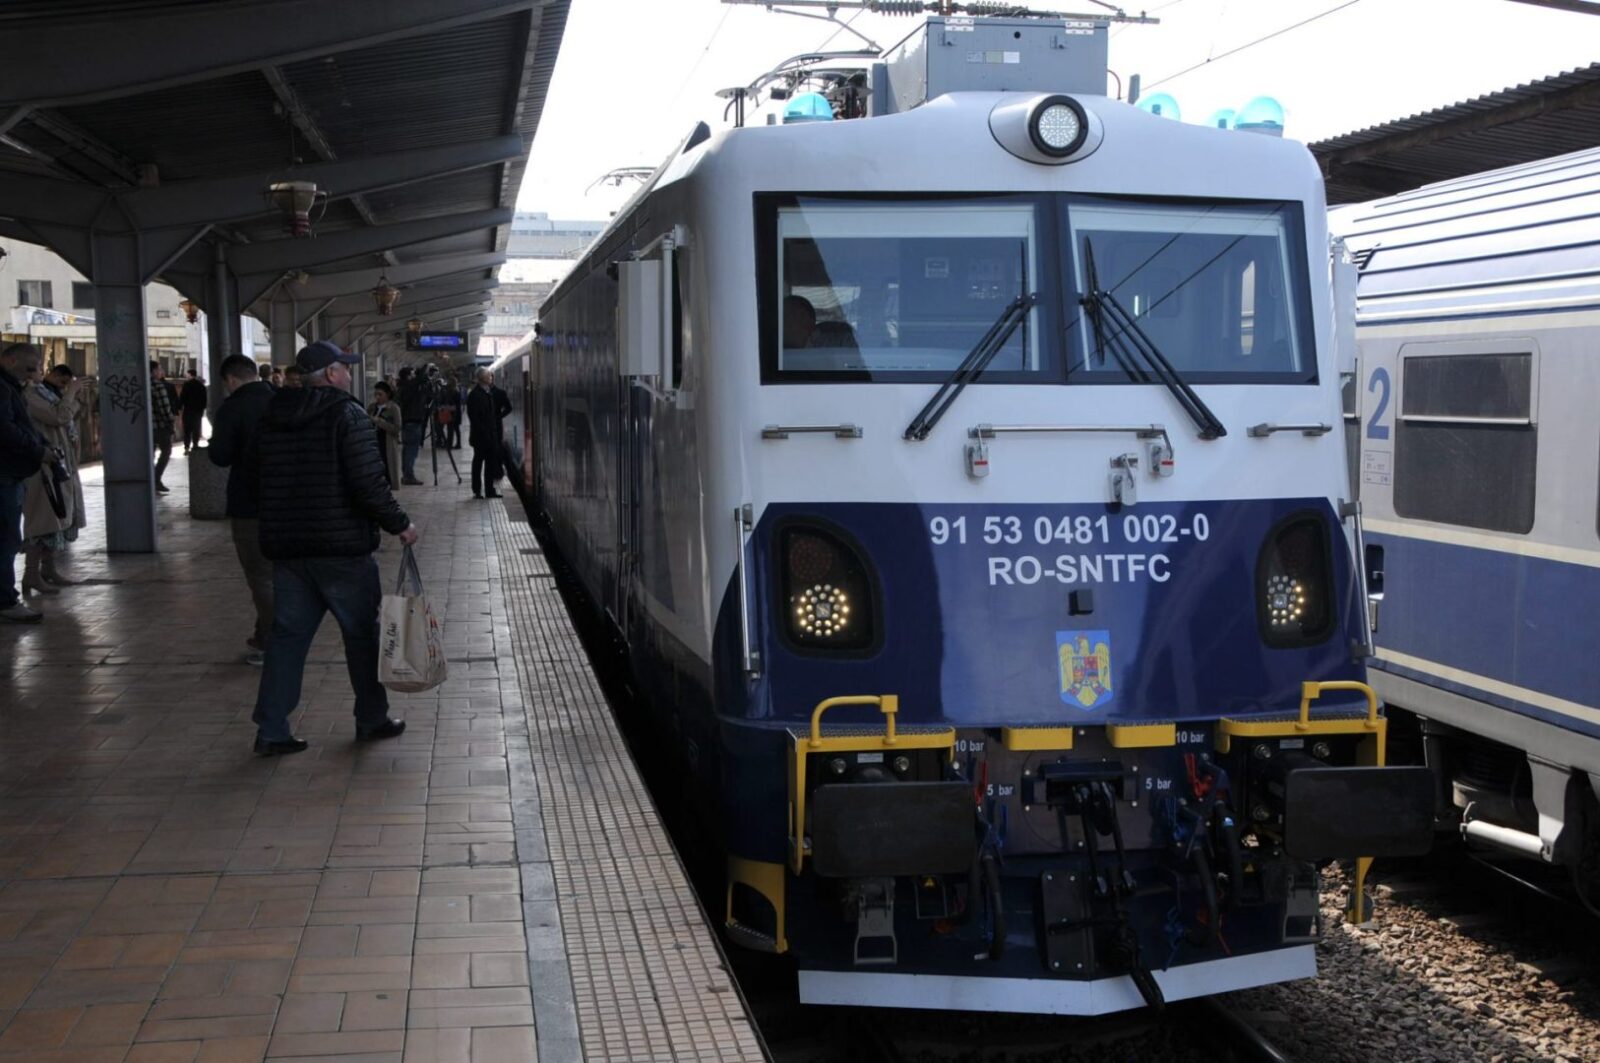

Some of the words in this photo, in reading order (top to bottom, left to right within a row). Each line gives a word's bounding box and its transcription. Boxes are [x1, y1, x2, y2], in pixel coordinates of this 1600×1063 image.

[1366, 367, 1391, 440] 2
[930, 516, 967, 545] 91
[983, 516, 1022, 545] 53
[1034, 515, 1110, 544] 0481
[1123, 513, 1210, 543] 002-0
[988, 554, 1171, 585] RO-SNTFC
[1176, 731, 1188, 743] 10
[1190, 731, 1205, 743] bar
[955, 739, 967, 752] 10
[969, 740, 985, 752] bar
[987, 784, 994, 796] 5
[998, 784, 1014, 796] bar
[1145, 777, 1153, 790] 5
[1157, 778, 1172, 789] bar
